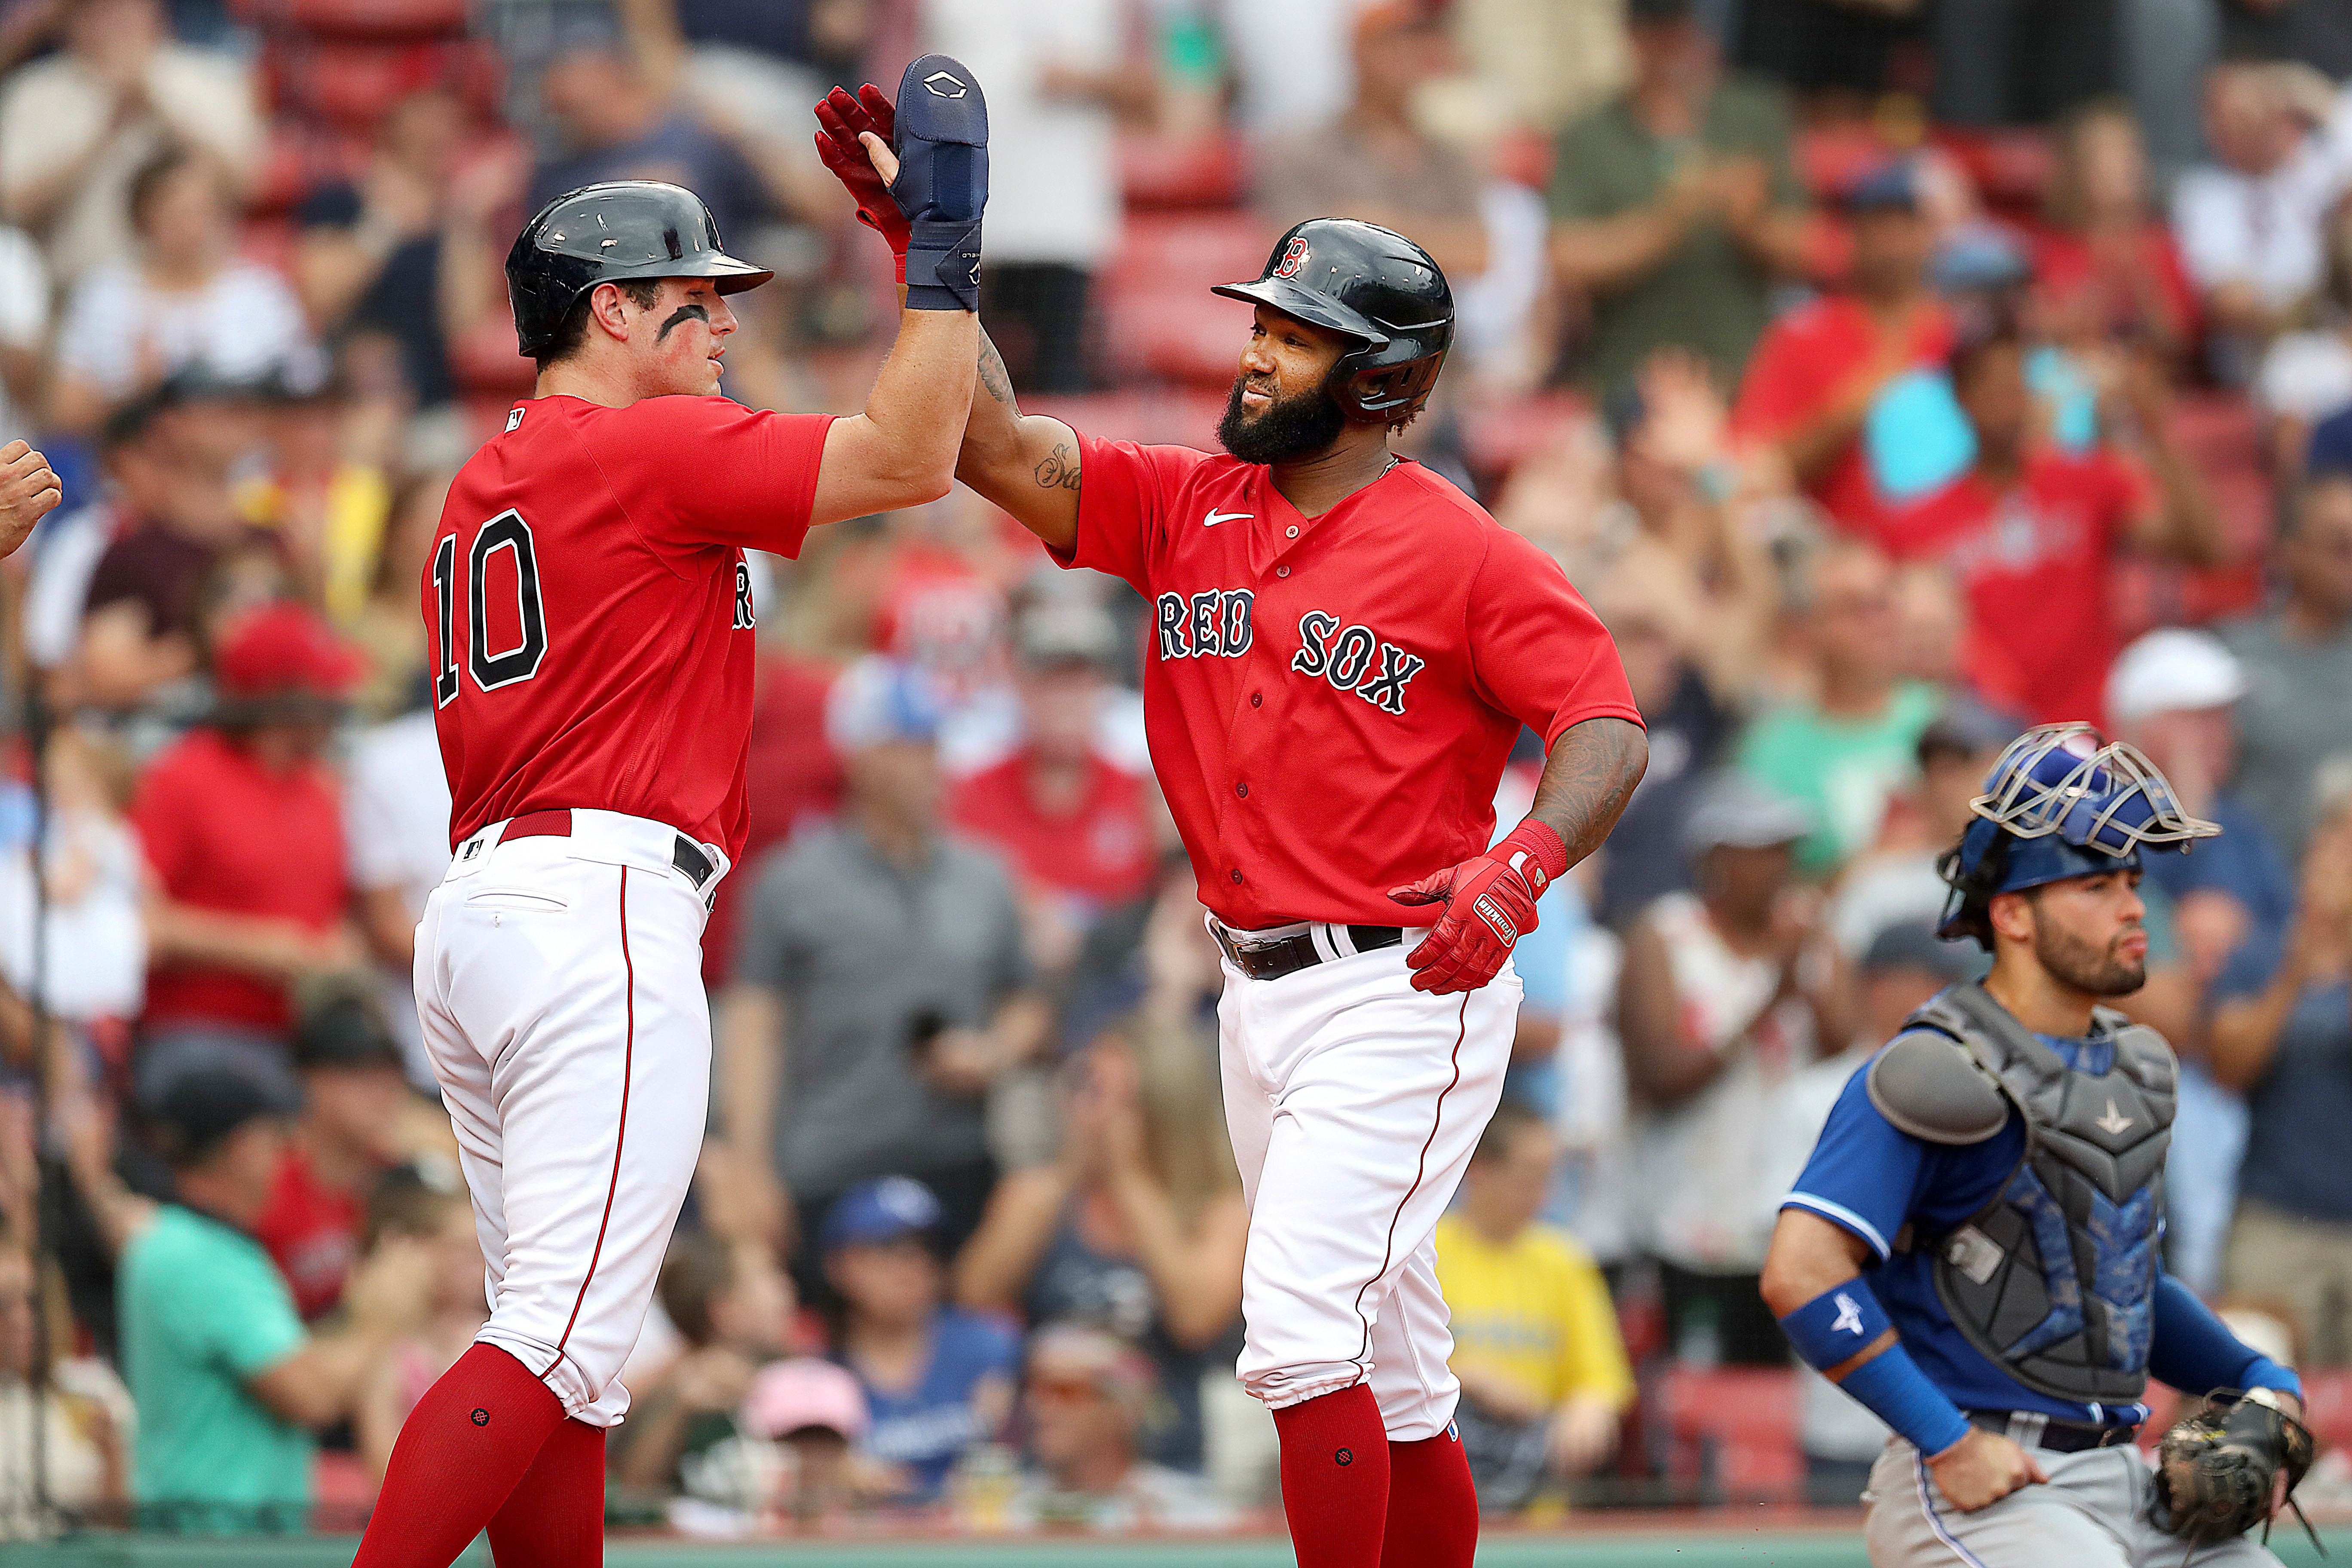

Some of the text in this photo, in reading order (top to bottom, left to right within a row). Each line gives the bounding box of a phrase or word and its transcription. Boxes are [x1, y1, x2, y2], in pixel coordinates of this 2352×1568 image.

[1273, 236, 1309, 278] B
[433, 508, 548, 710] 10
[1157, 588, 1424, 715] RED SOX
